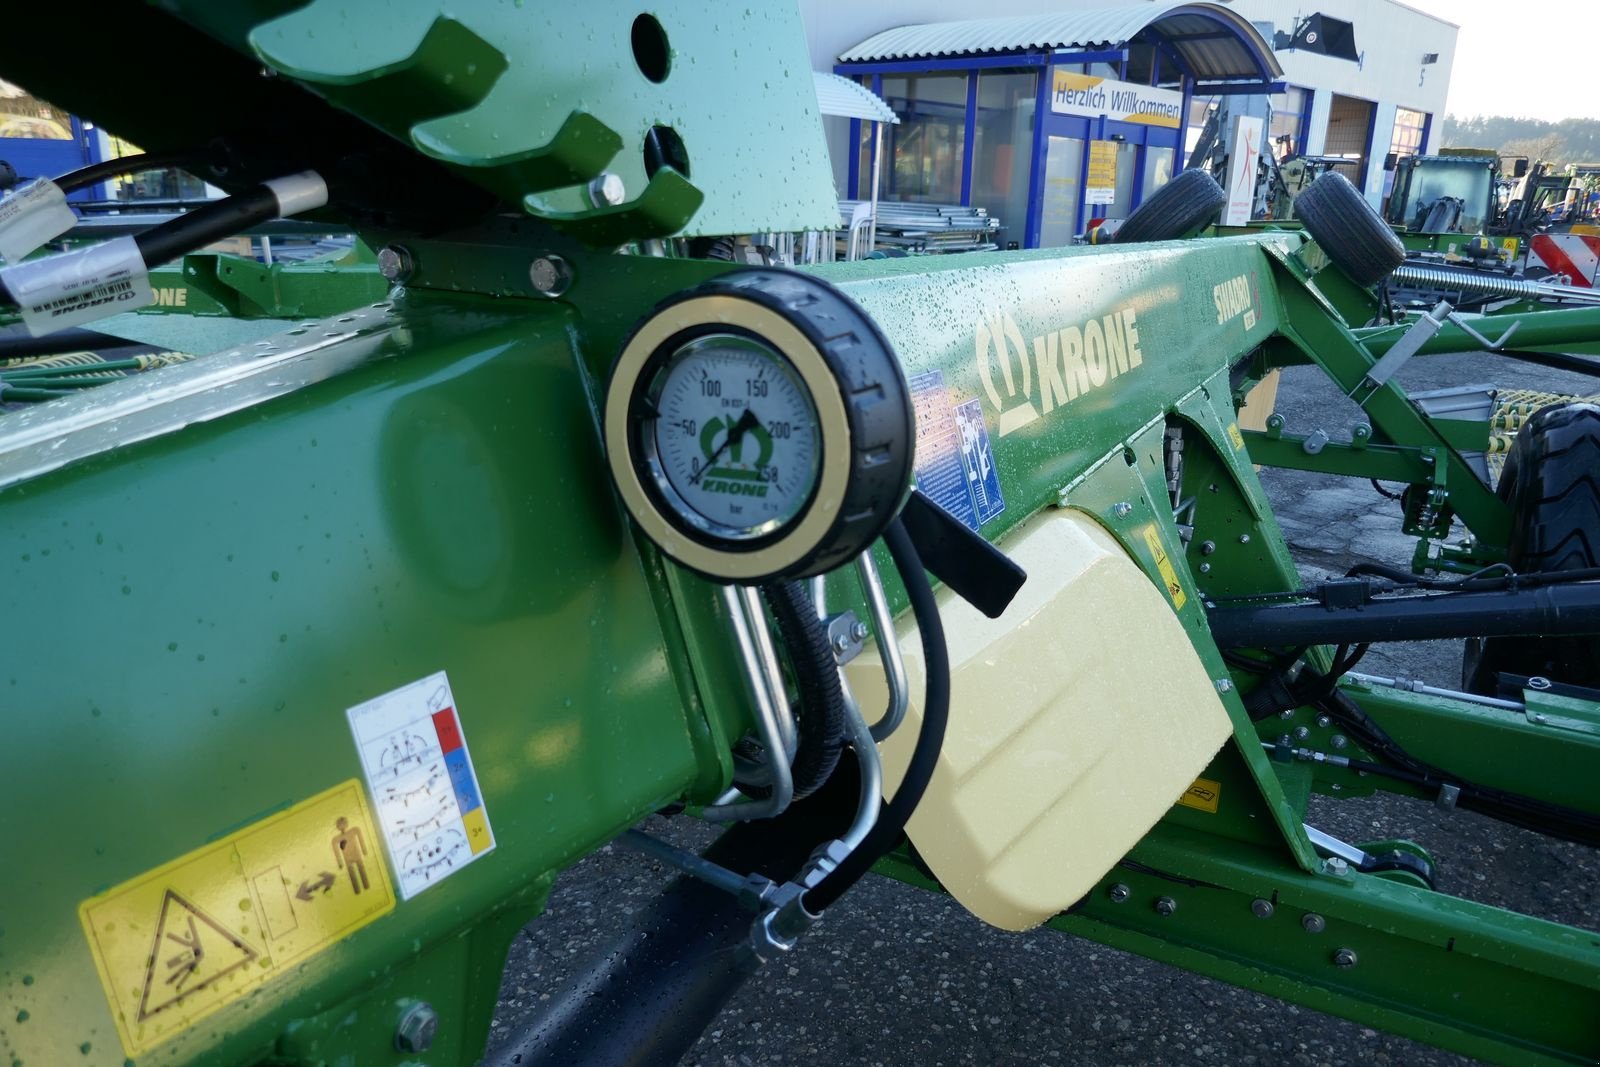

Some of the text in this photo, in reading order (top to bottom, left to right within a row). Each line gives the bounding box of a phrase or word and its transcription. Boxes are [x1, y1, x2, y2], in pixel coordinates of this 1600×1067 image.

[1055, 82, 1180, 119] Herzlich Willkommen
[1033, 307, 1143, 414] KRONE
[700, 379, 722, 397] 100
[746, 379, 769, 398] 150
[682, 420, 697, 437] 50
[768, 420, 791, 440] 200
[692, 456, 700, 475] 0
[702, 479, 769, 499] KRONE
